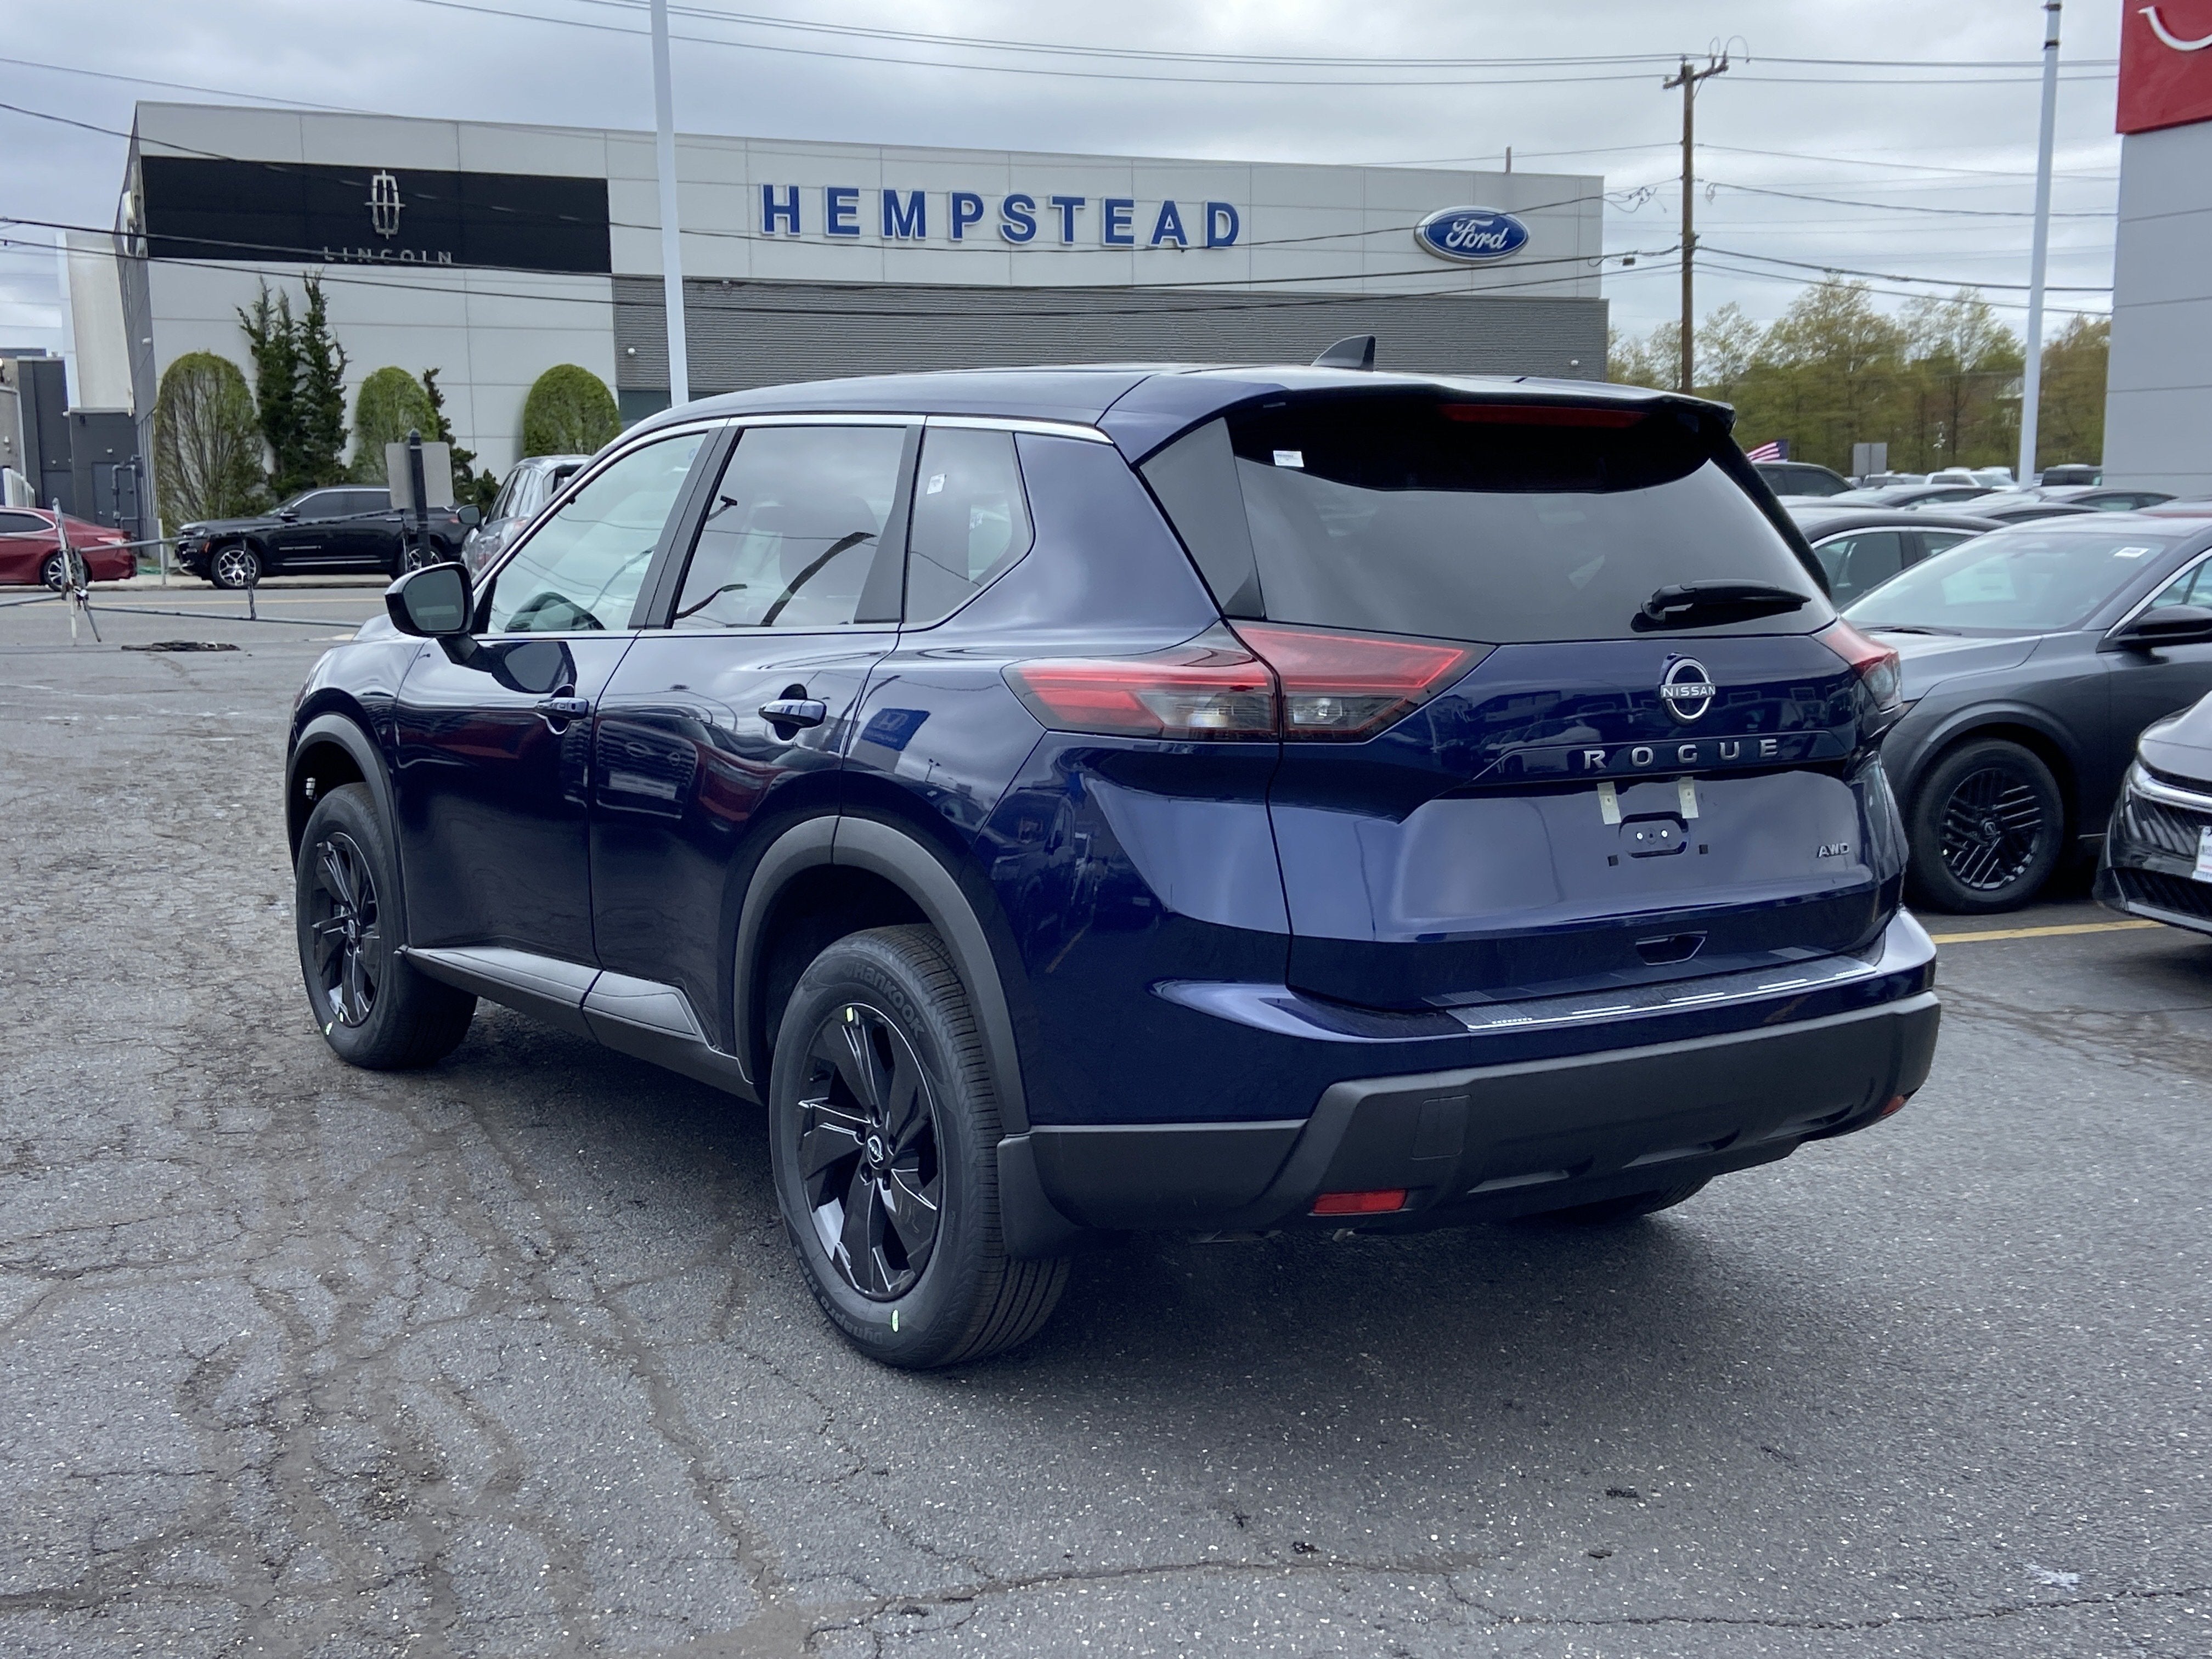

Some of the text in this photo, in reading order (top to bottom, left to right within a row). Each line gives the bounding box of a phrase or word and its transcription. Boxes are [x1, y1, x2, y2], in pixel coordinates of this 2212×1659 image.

[761, 183, 1241, 249] HEMPSTEAD
[1446, 218, 1509, 250] Ford
[1662, 684, 1716, 697] NISSAN
[1584, 738, 1779, 769] ROGUE
[1817, 842, 1850, 858] AWD
